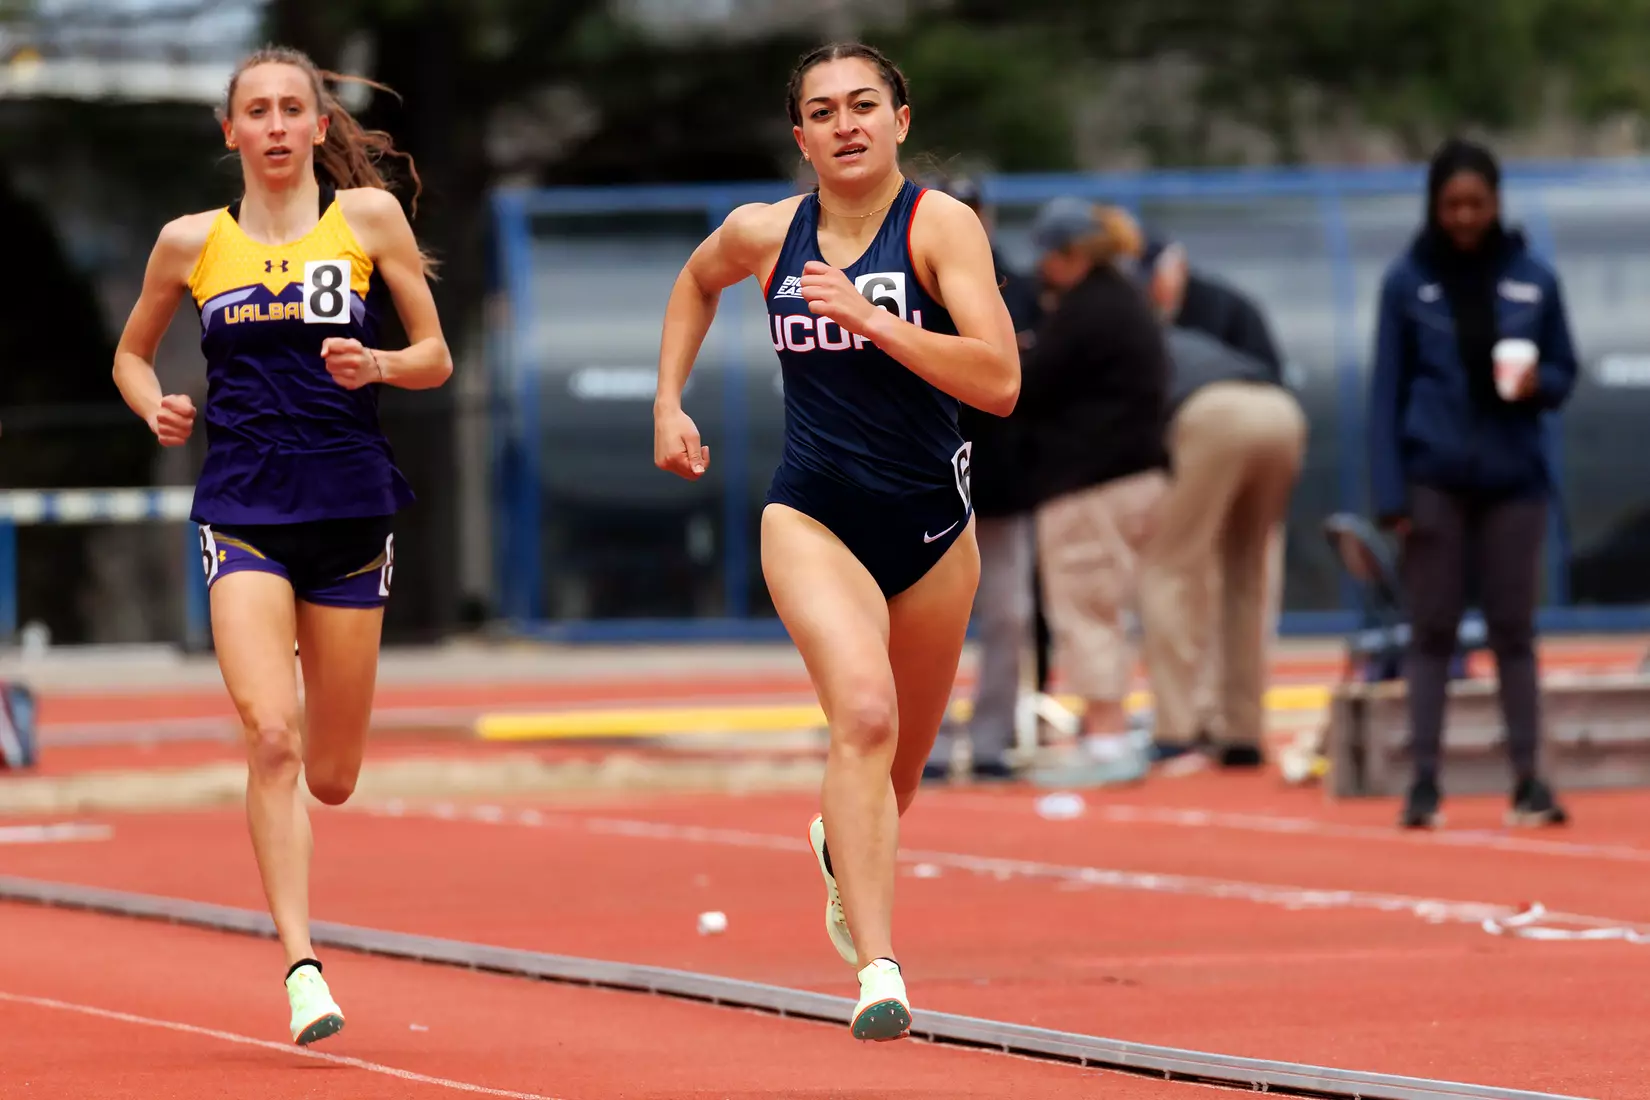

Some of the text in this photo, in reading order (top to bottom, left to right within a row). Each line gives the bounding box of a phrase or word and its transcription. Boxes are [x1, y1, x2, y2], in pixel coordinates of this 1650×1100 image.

[309, 264, 344, 318] 8
[776, 285, 803, 296] EAS
[861, 276, 900, 320] 6
[224, 301, 305, 325] UALBA
